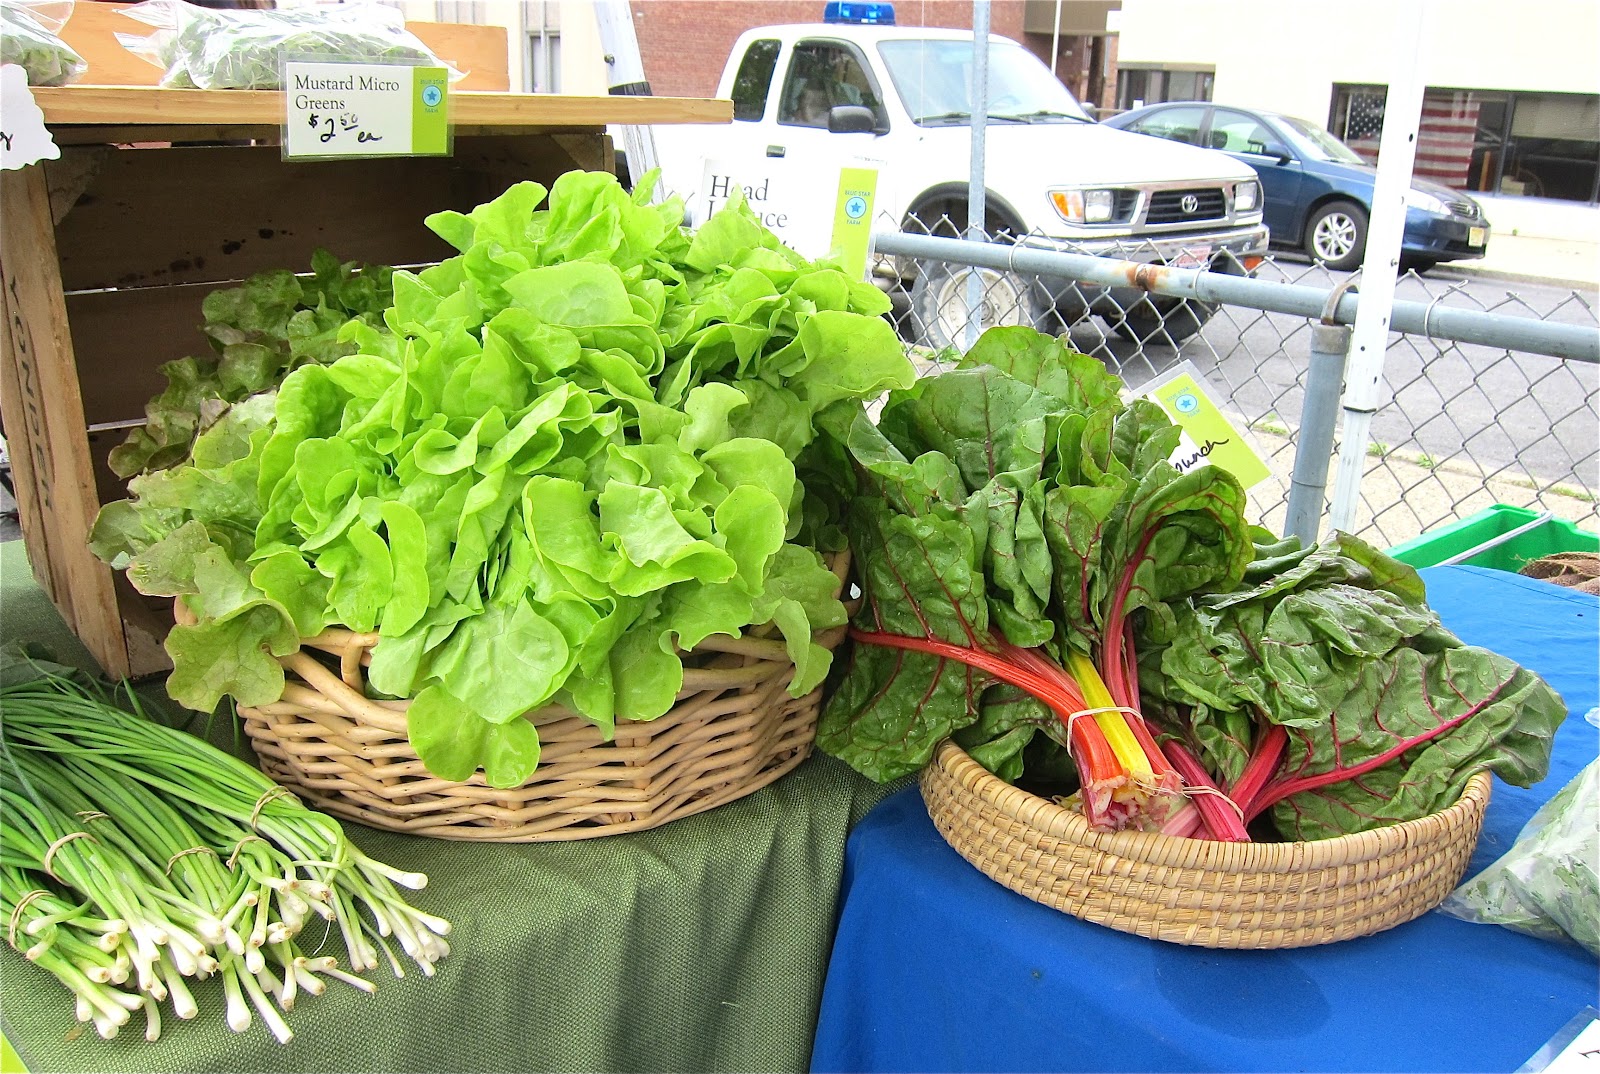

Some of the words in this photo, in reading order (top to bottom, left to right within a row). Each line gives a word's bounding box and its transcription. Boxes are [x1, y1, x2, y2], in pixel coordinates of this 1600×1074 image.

[294, 73, 354, 91] Mustard
[359, 75, 400, 92] Micro
[295, 94, 346, 111] Greens
[357, 131, 383, 144] ea
[709, 174, 769, 201] Had
